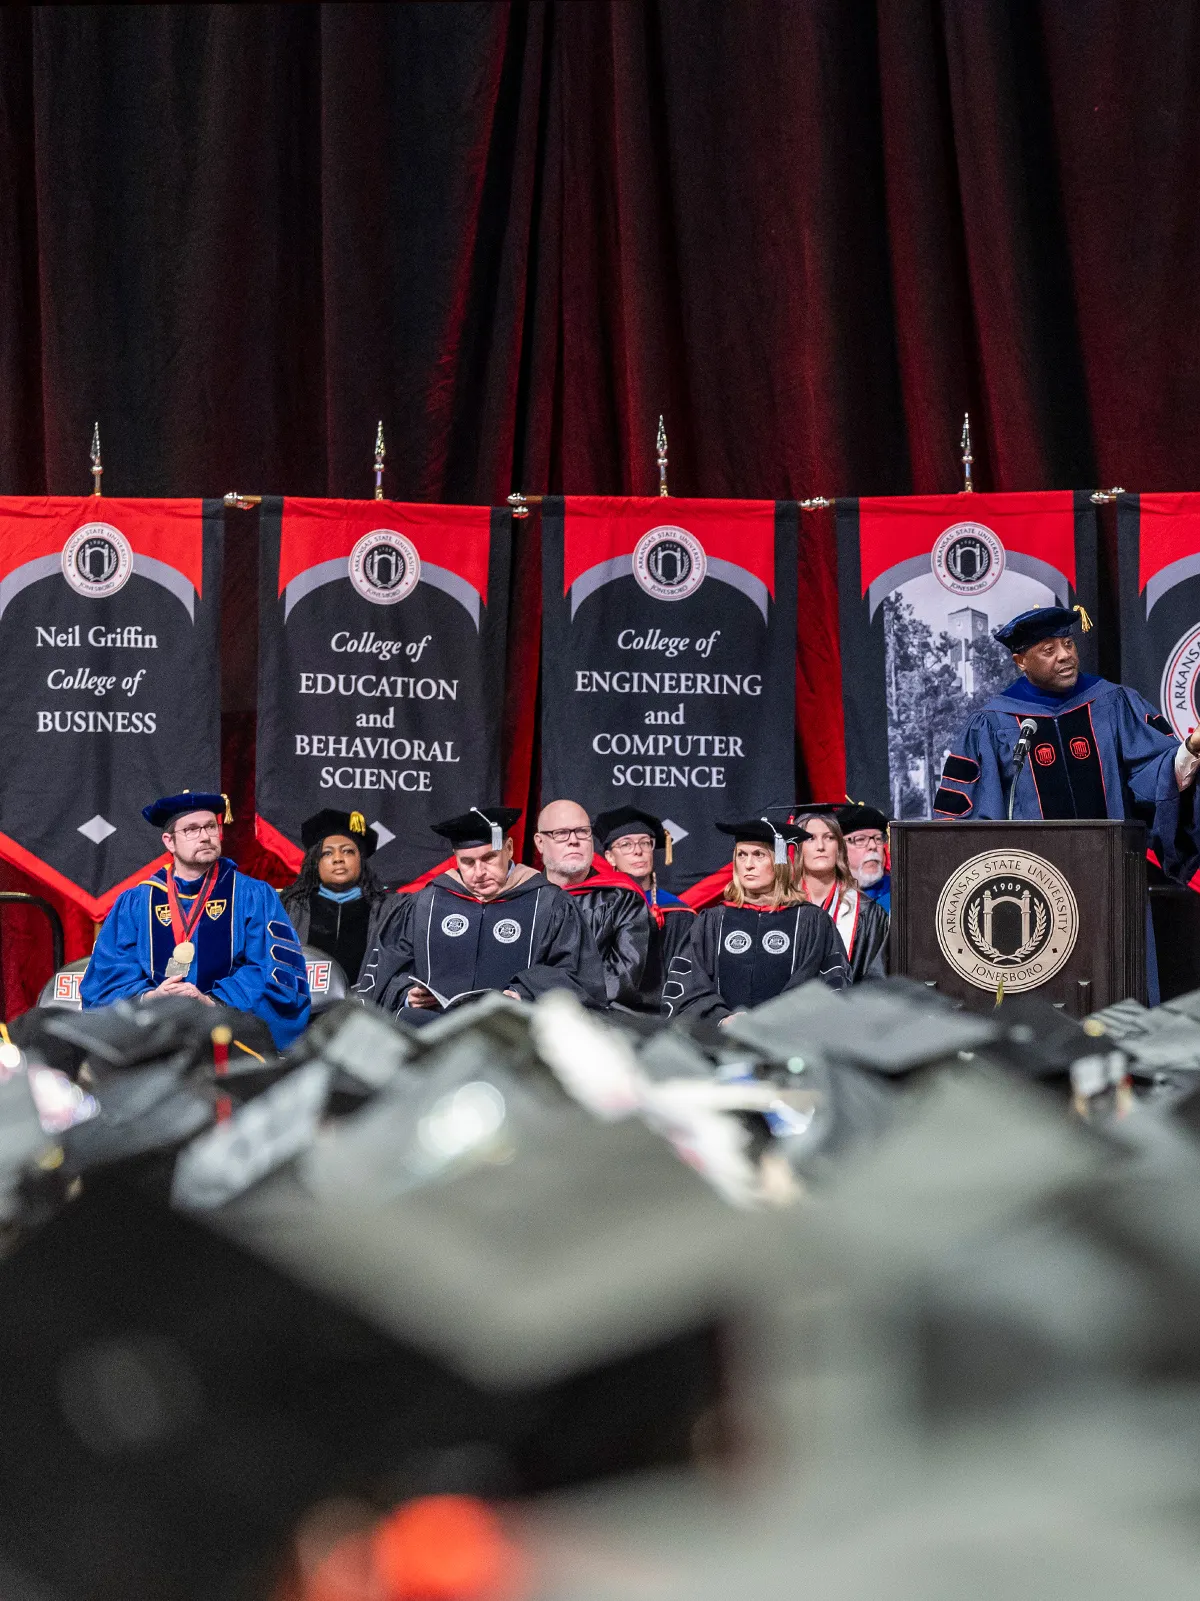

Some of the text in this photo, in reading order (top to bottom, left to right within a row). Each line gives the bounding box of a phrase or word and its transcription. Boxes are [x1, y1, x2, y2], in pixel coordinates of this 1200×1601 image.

[937, 534, 954, 567] ARKANSAS
[978, 530, 1000, 565] UNIVERSITY
[950, 581, 987, 591] JONESBORO
[36, 625, 157, 648] Neil Griffin
[331, 632, 432, 662] College of
[618, 629, 720, 657] College of
[47, 668, 146, 696] College of
[299, 673, 458, 700] EDUCATION
[576, 671, 761, 695] ENGINEERING
[38, 711, 156, 733] BUSINESS
[356, 707, 394, 728] and
[645, 704, 684, 724] and
[296, 735, 459, 762] BEHAVIORAL
[593, 734, 744, 757] COMPUTER
[320, 767, 432, 791] SCIENCE
[612, 765, 725, 787] SCIENCE
[946, 860, 1067, 934] ARKANSAS STATE UNIVERSITY
[992, 882, 1021, 892] 1909
[971, 963, 1043, 982] JONESBORO
